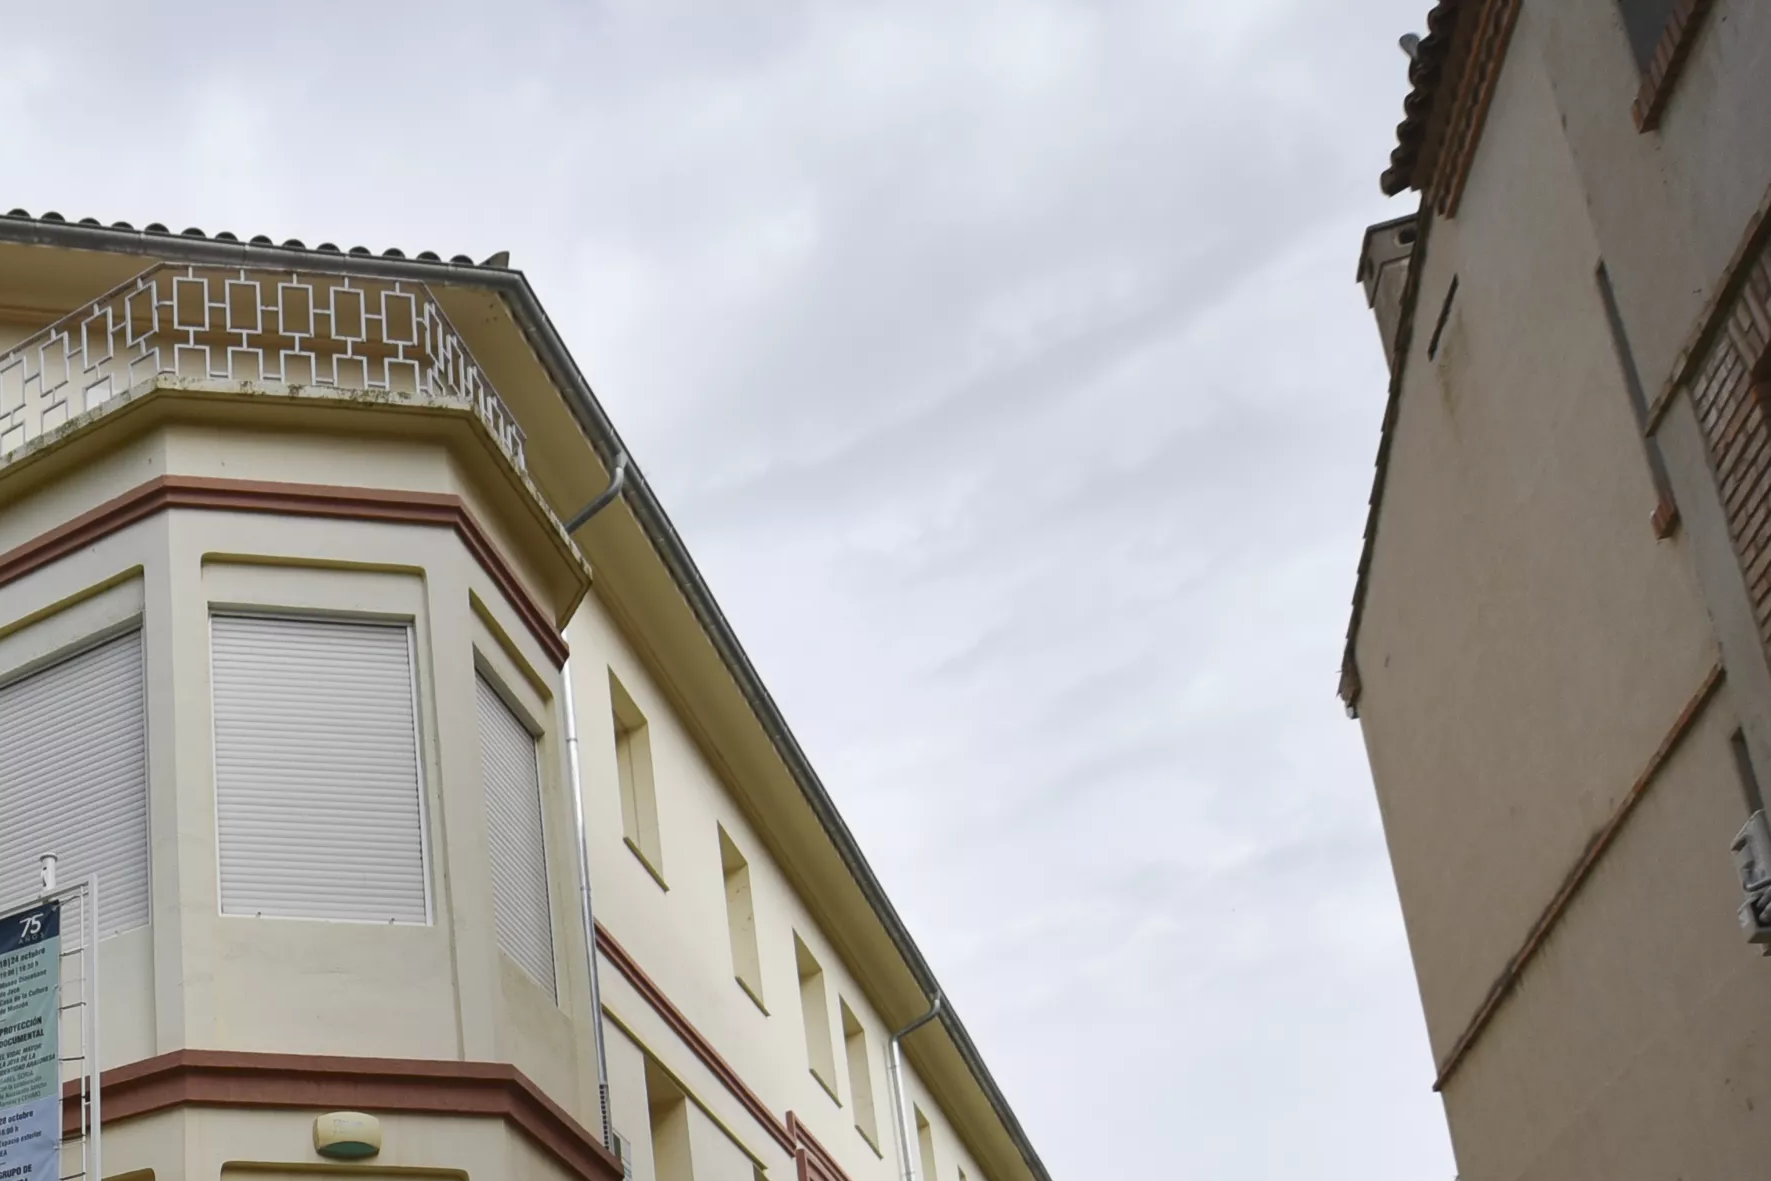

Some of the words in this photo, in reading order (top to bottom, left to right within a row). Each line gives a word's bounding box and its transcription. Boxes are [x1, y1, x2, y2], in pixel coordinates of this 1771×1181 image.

[20, 914, 43, 937] 75
[21, 948, 45, 961] octubre
[0, 1017, 42, 1036] PROYECCIÓN
[0, 1029, 43, 1048] DOCUMENTAL
[8, 1111, 33, 1123] octubre
[21, 1131, 41, 1141] exterior
[23, 1164, 32, 1173] DE
